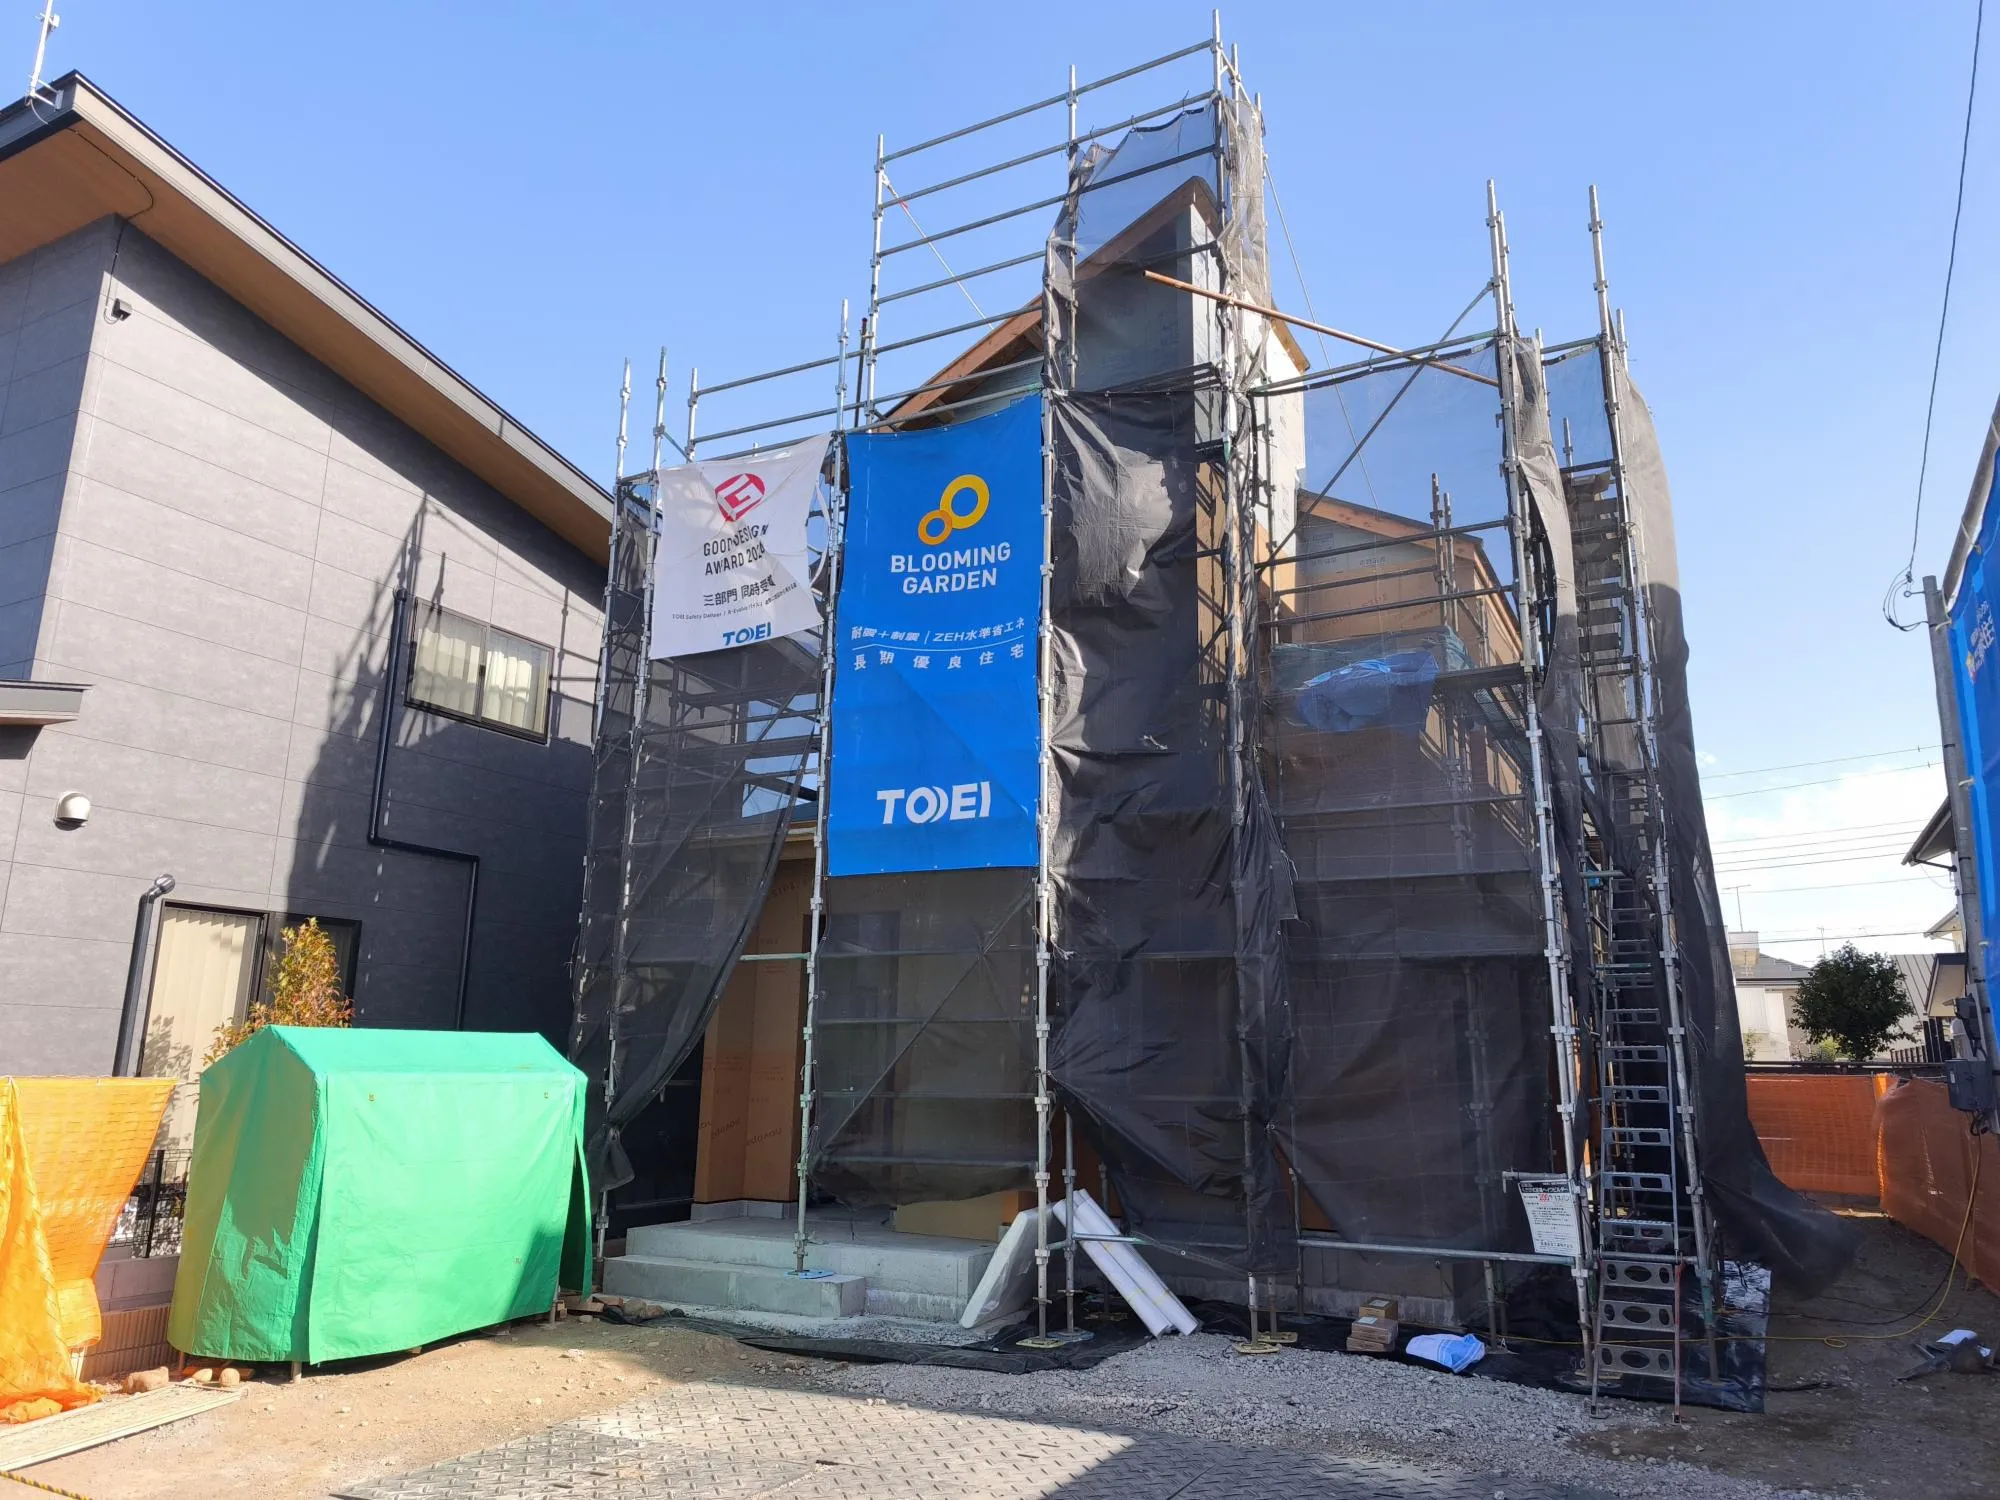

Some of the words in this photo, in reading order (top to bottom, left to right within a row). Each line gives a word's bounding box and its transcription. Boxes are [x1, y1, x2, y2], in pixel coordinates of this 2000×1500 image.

[705, 552, 744, 576] AWARD
[890, 541, 1011, 573] BLOOMING
[902, 568, 998, 594] GARDEN
[703, 588, 738, 606] 三部門
[722, 621, 772, 646] TOEI
[853, 644, 1025, 671] 長期優良住宅
[876, 781, 991, 825] TOEI
